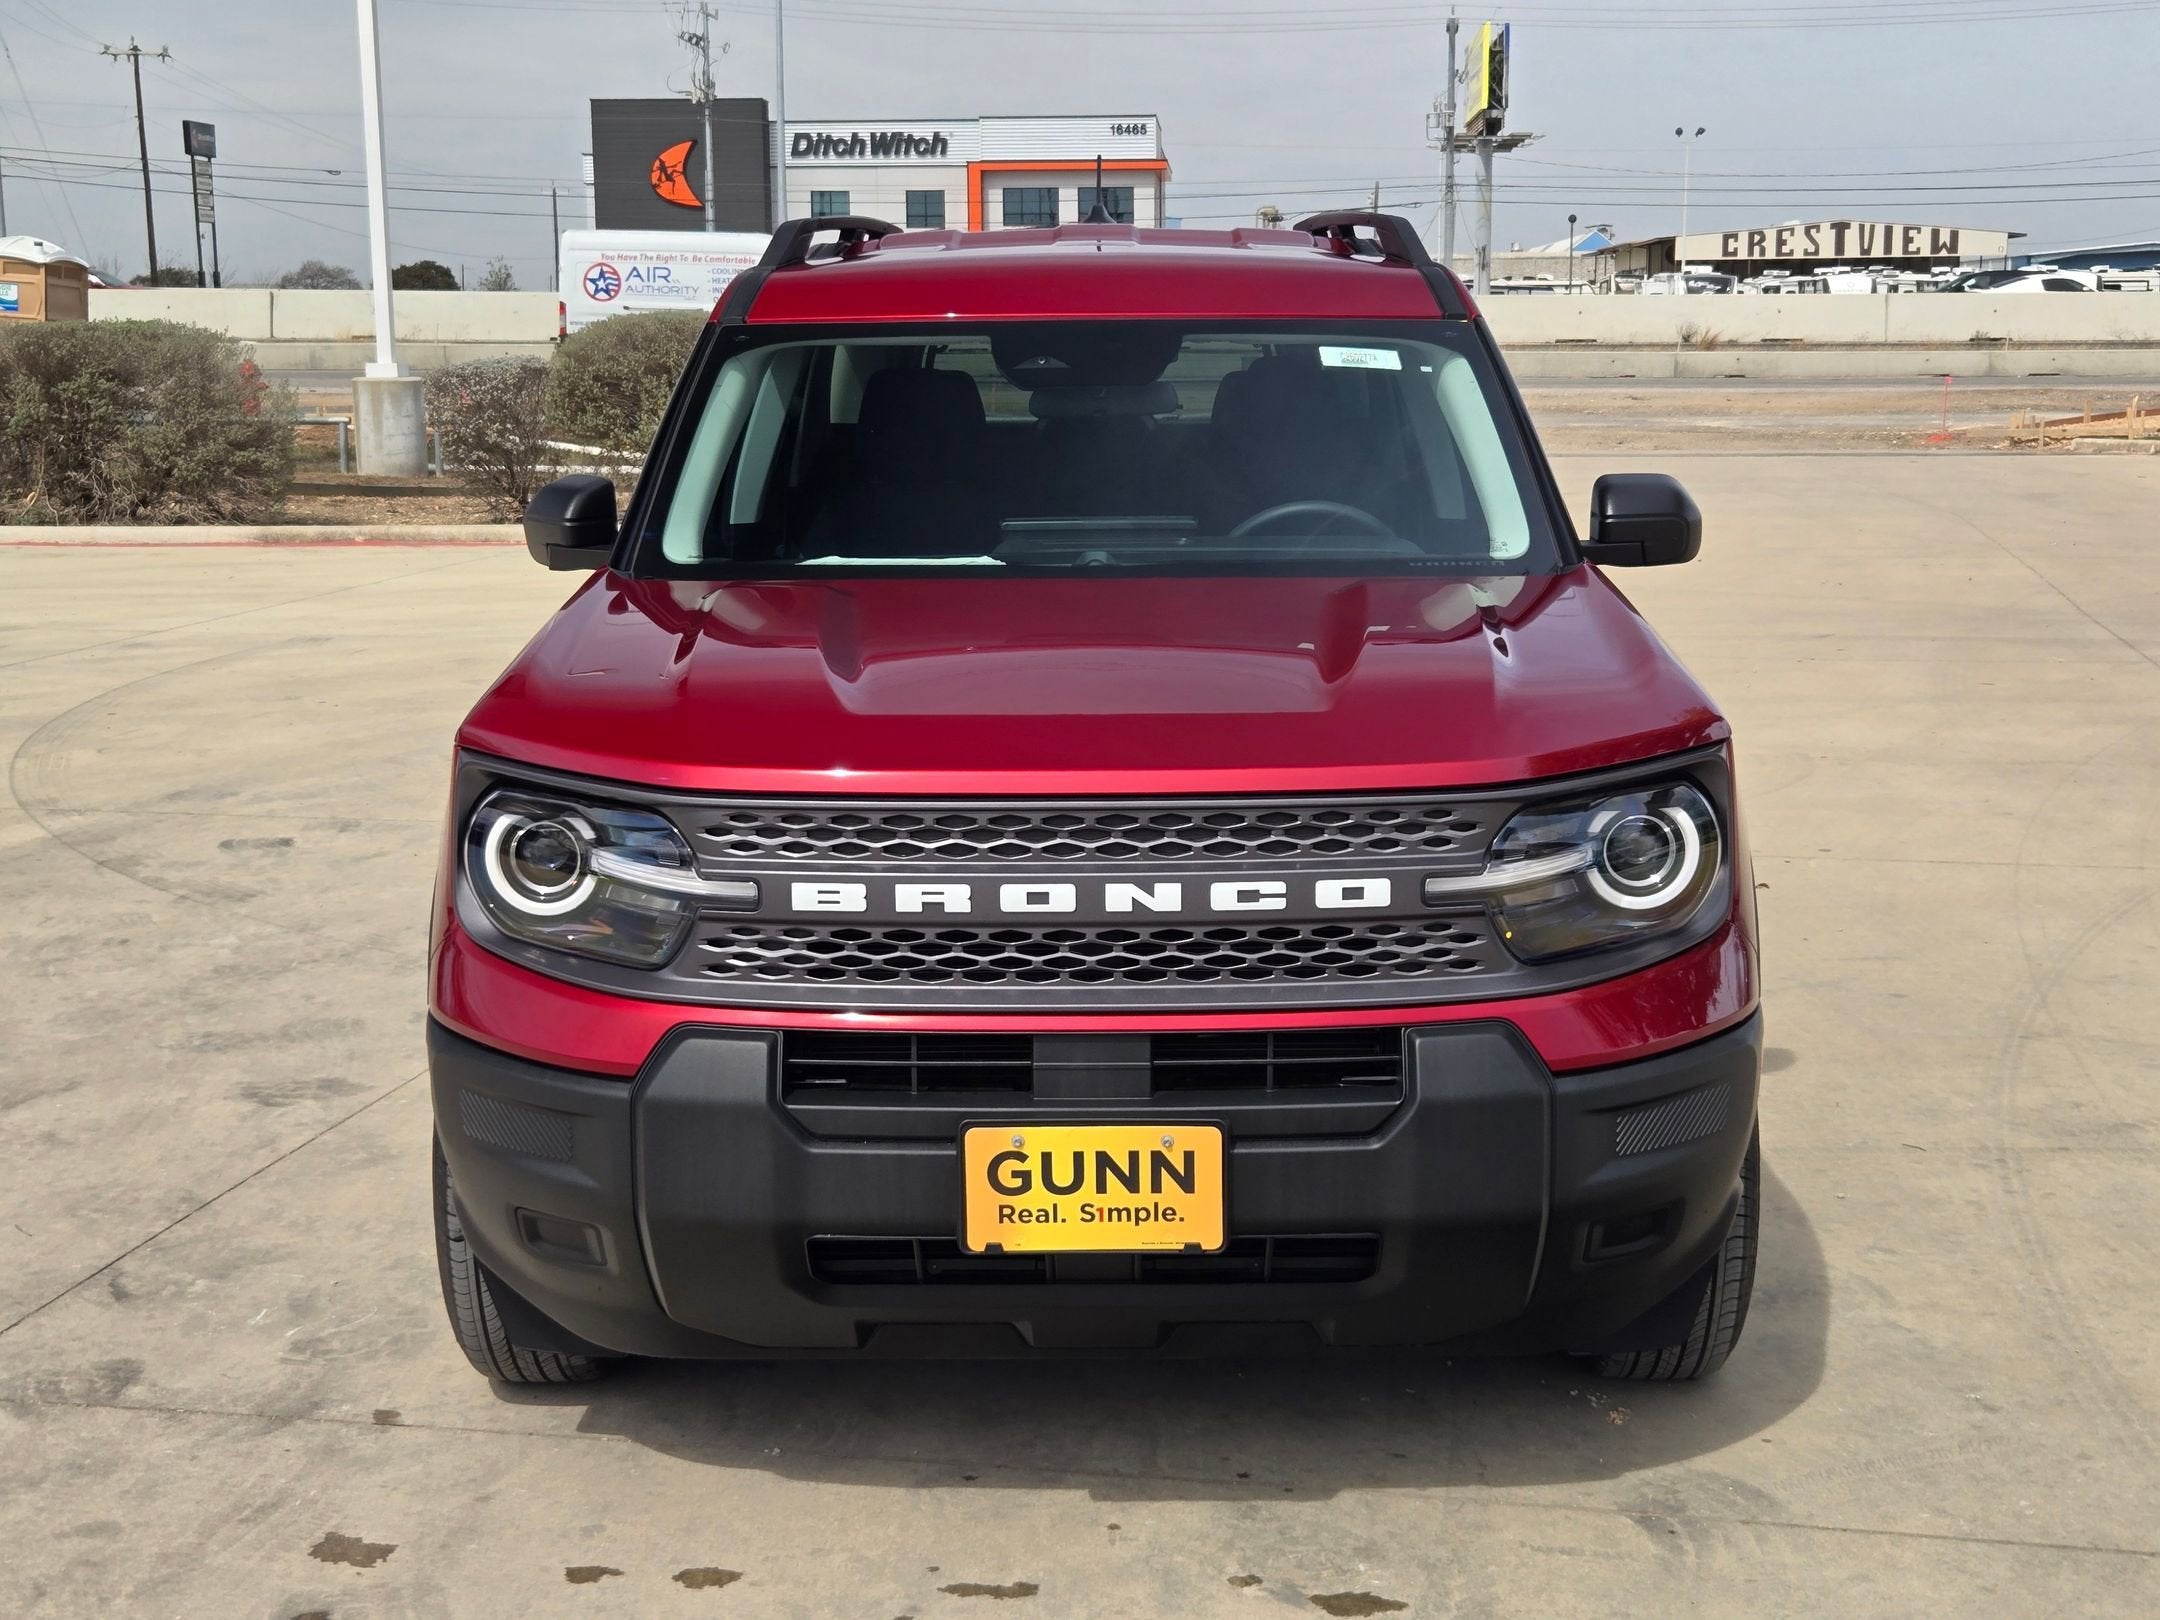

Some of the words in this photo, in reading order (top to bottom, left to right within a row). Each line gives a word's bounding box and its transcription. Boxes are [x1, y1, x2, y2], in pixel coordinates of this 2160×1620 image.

[1110, 124, 1147, 136] 16465
[791, 132, 867, 159] Ditch
[870, 132, 949, 158] Witch
[1722, 222, 1959, 257] CRESTVIEW
[601, 253, 615, 261] You
[617, 253, 638, 261] Have
[656, 254, 678, 264] Right
[680, 254, 689, 262] To
[704, 255, 756, 264] Comfortable
[625, 266, 671, 283] AIR
[625, 285, 699, 295] AUTHORITY
[791, 878, 1391, 912] BRONCO
[987, 1150, 1195, 1196] GUNN
[999, 1203, 1066, 1224] Real.
